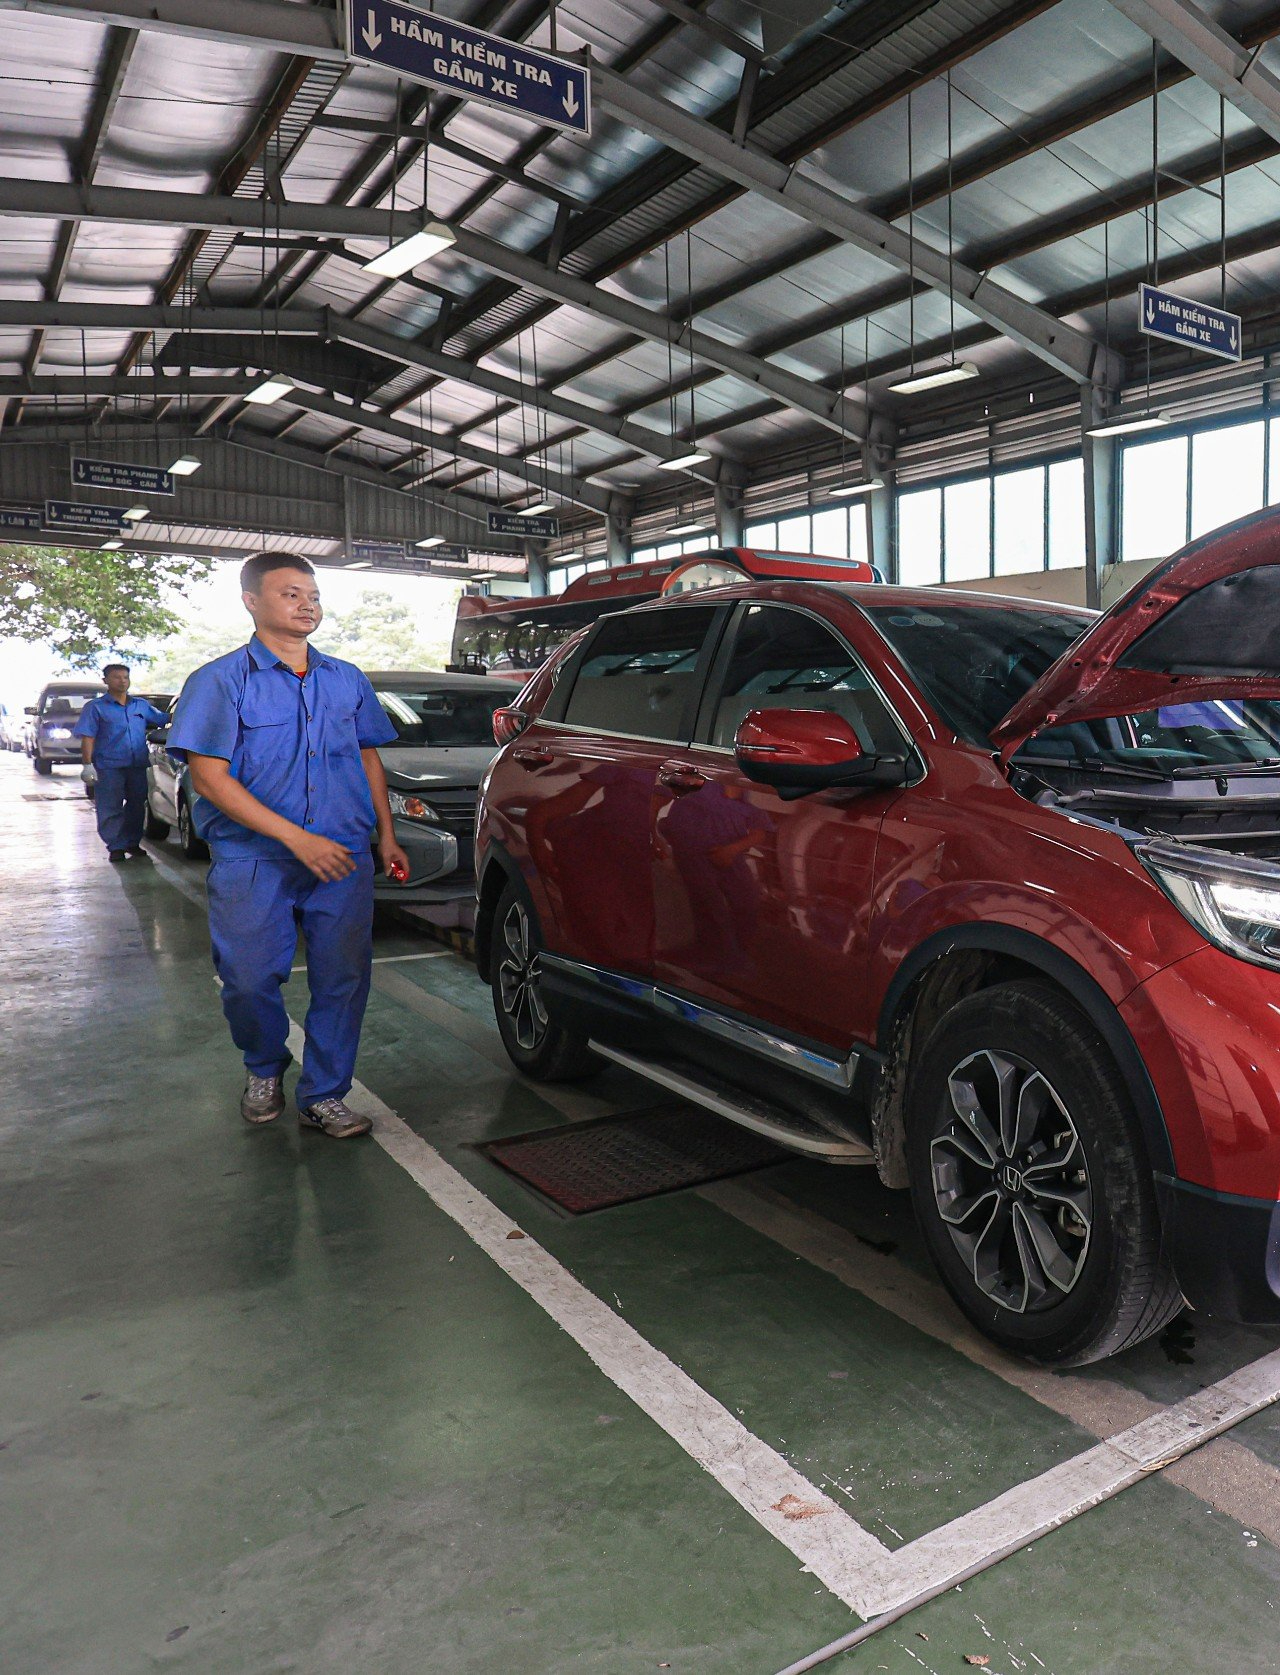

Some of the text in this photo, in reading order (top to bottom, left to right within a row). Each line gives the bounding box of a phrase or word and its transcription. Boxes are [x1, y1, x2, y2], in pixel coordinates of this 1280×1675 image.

[391, 16, 552, 87] HẦM KIỂM TRA
[433, 57, 518, 99] GẦM XE
[1182, 308, 1205, 324] KIỂM
[1208, 317, 1225, 331] TRA
[1199, 330, 1211, 342] XE
